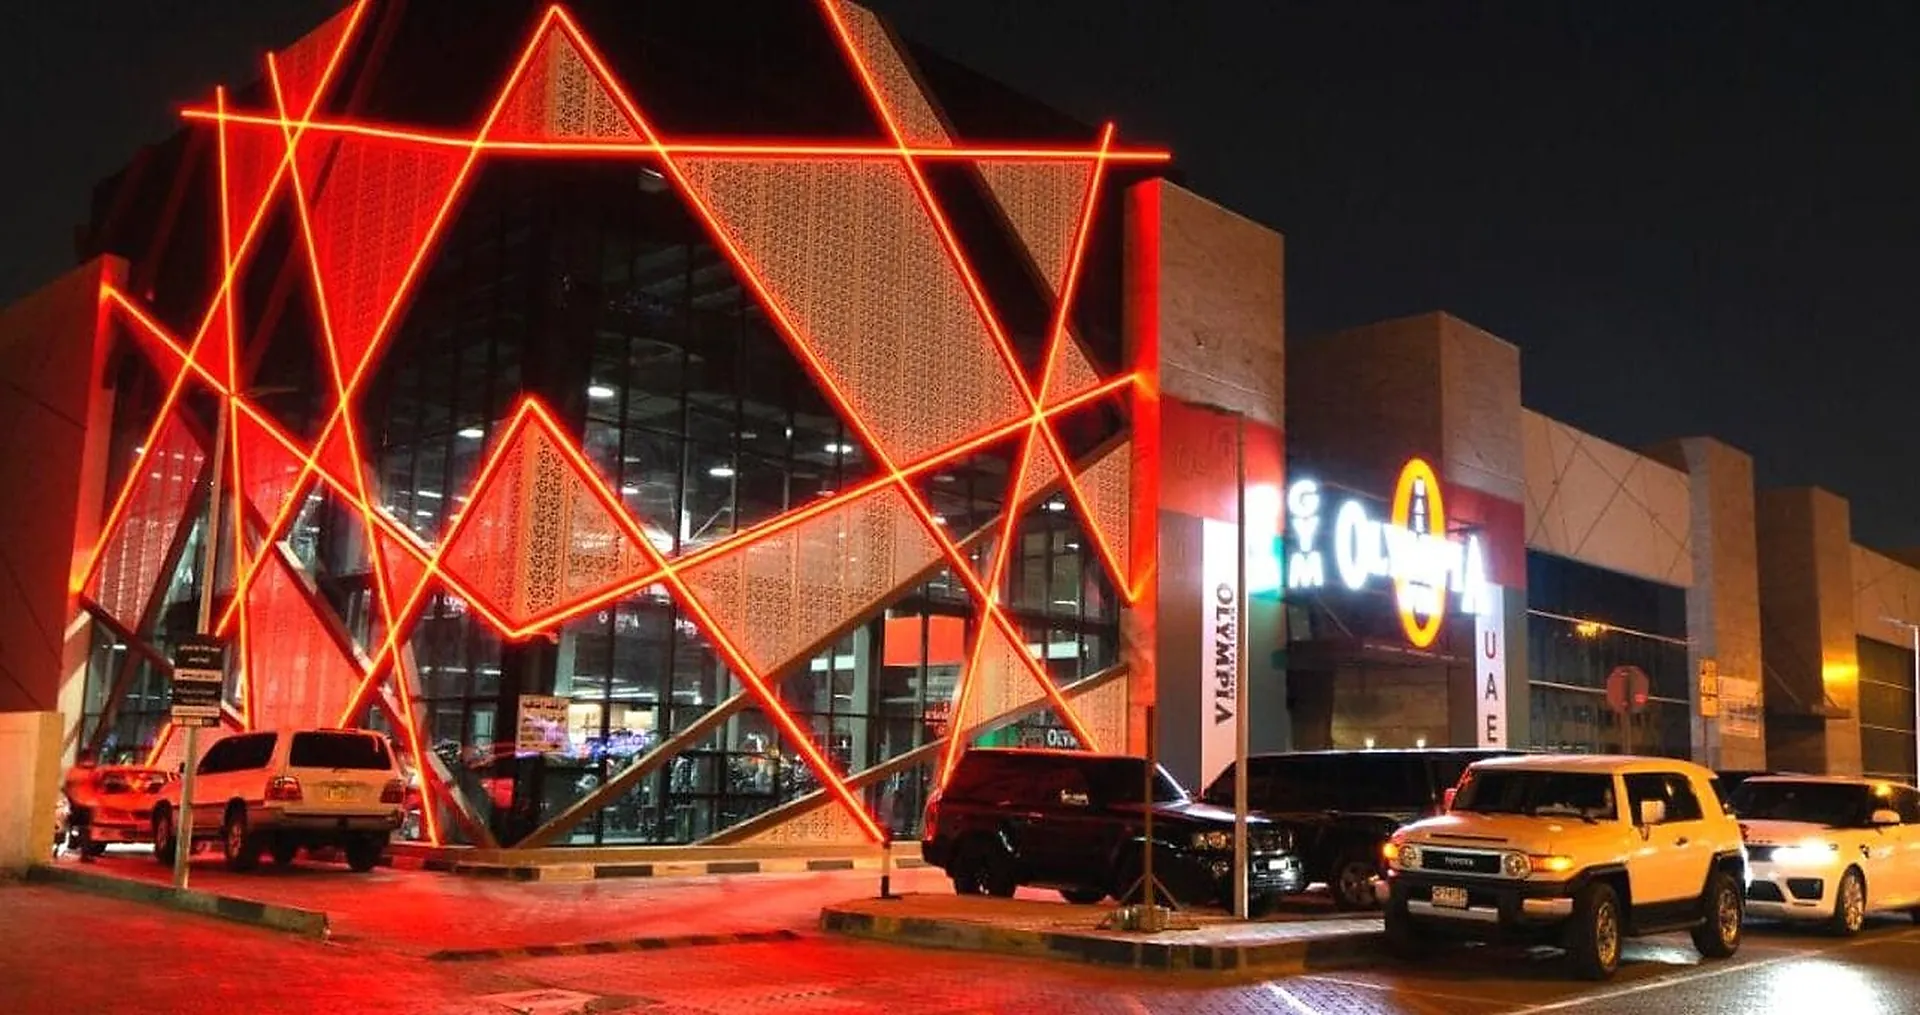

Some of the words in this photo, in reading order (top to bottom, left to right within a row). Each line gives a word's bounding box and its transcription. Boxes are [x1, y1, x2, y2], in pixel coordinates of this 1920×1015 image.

[1288, 480, 1323, 588] GYM
[1336, 500, 1491, 616] OLYIA
[1216, 582, 1234, 726] OLYMPIA
